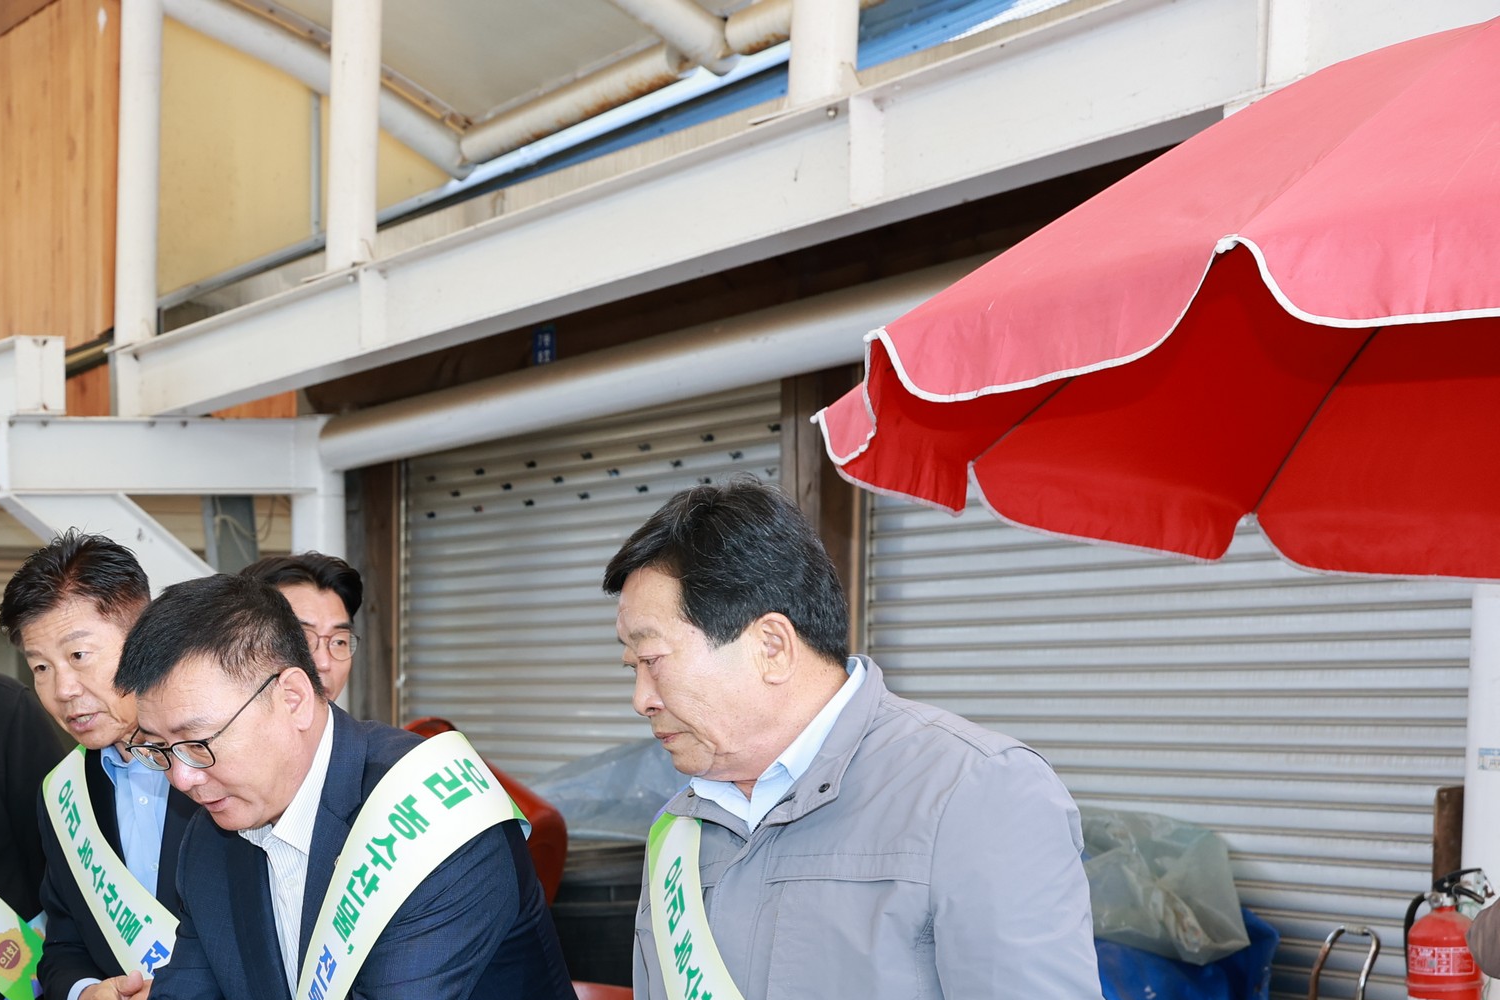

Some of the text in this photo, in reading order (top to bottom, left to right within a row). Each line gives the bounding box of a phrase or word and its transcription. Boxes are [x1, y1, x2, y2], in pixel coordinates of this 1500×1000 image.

[420, 757, 491, 810] 우리
[58, 779, 82, 842] 우리
[76, 836, 153, 947] 농수산물,
[331, 794, 431, 956] 농수산물,
[663, 855, 687, 937] 우리
[0, 941, 19, 968] 의회
